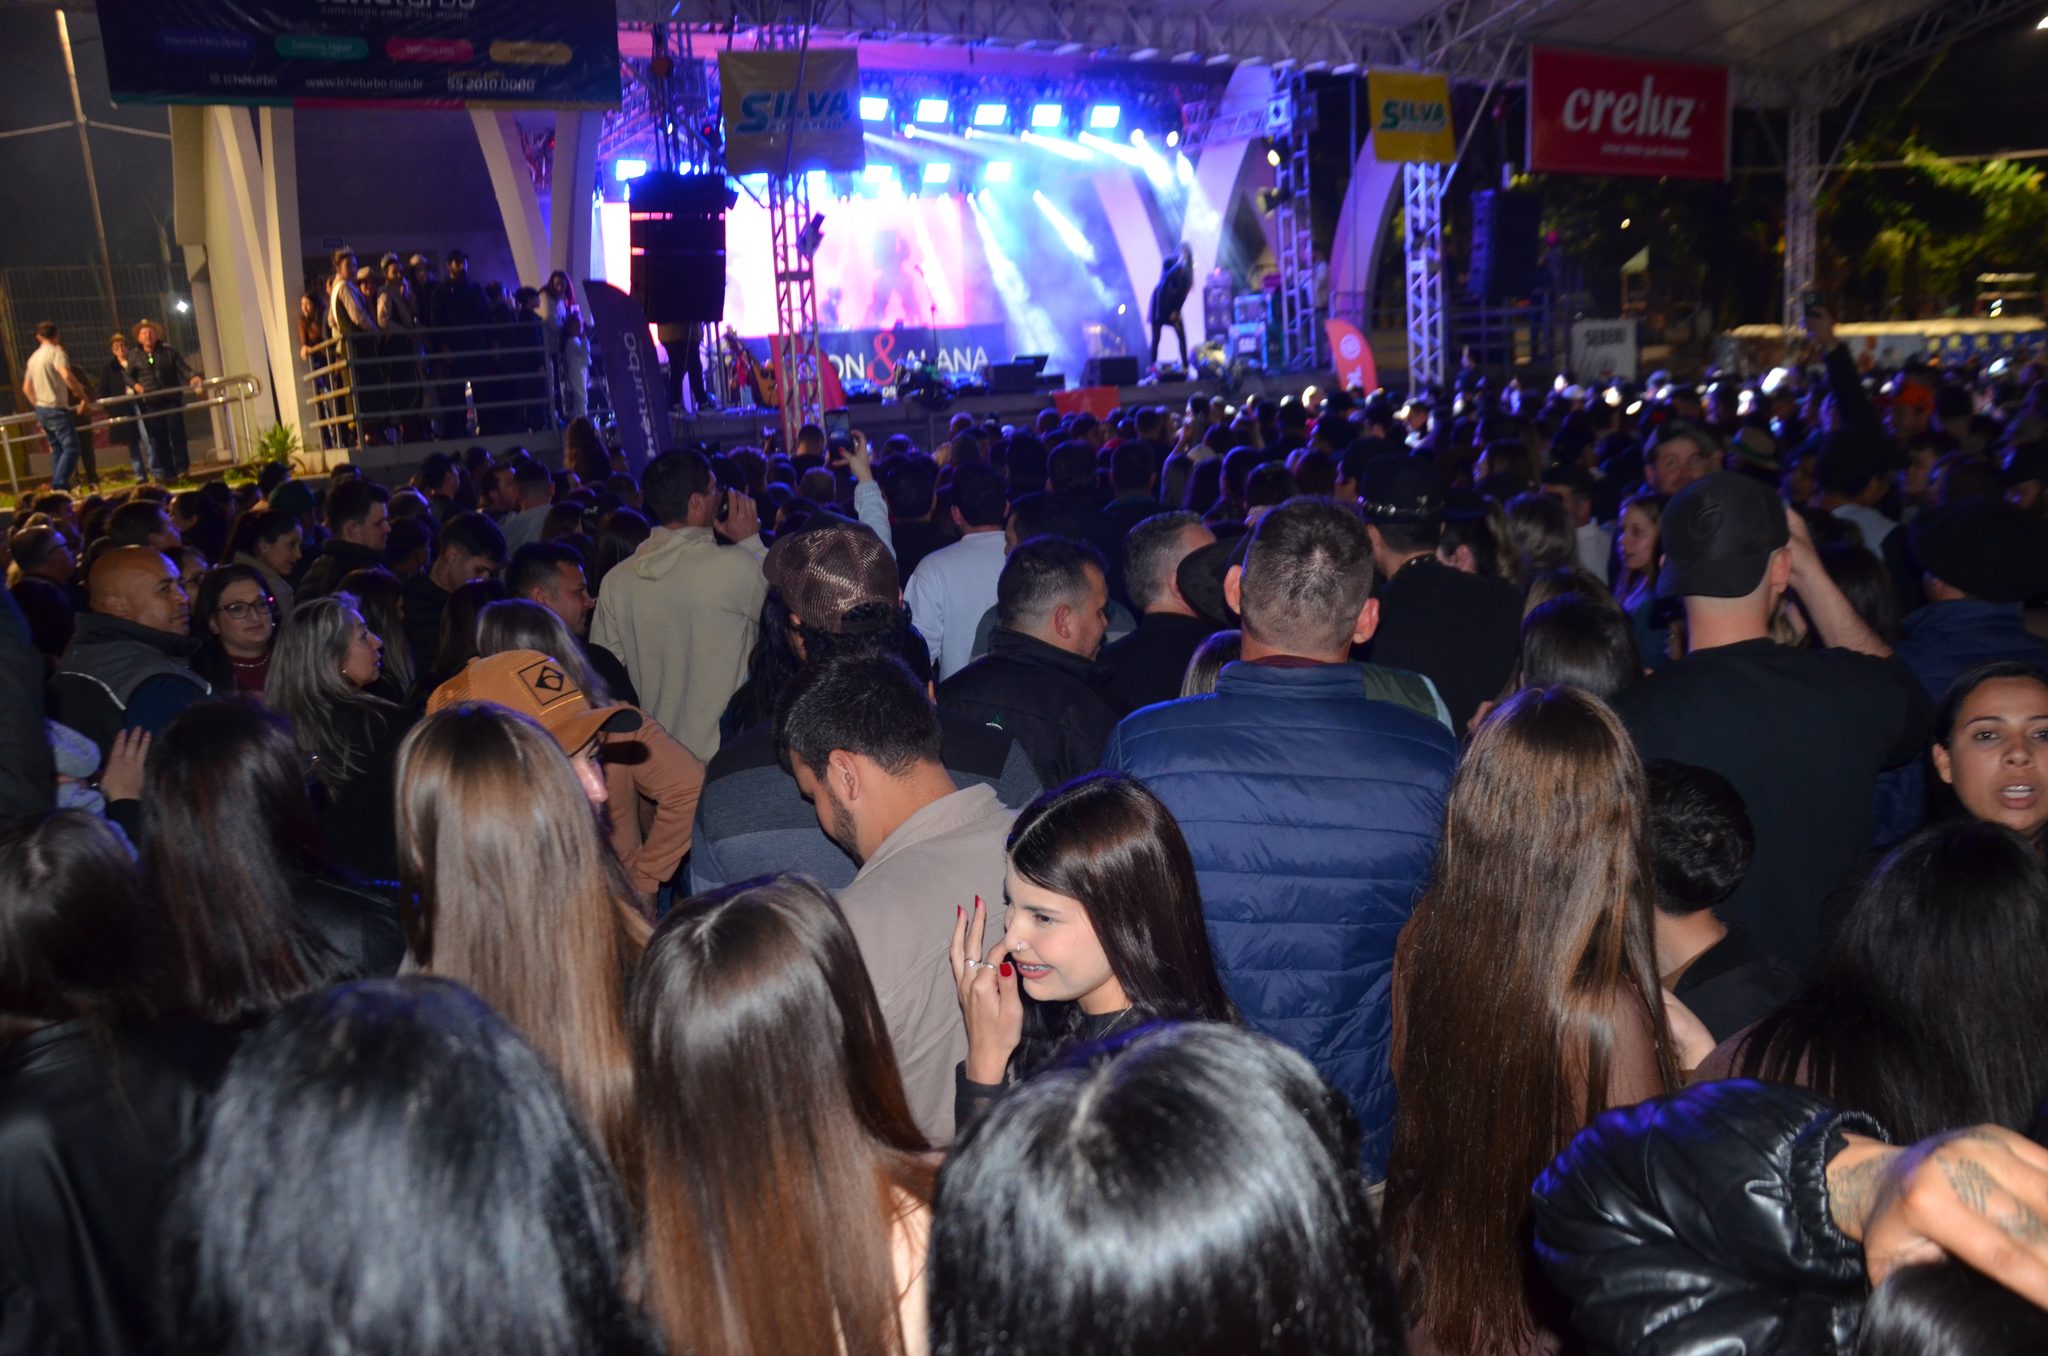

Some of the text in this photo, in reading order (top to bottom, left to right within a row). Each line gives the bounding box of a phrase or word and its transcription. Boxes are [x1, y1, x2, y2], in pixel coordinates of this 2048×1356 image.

[735, 90, 850, 132] SILVA
[1378, 100, 1446, 130] SILVA
[1562, 73, 1697, 139] creluz
[866, 332, 895, 385] &
[906, 346, 989, 373] AANA
